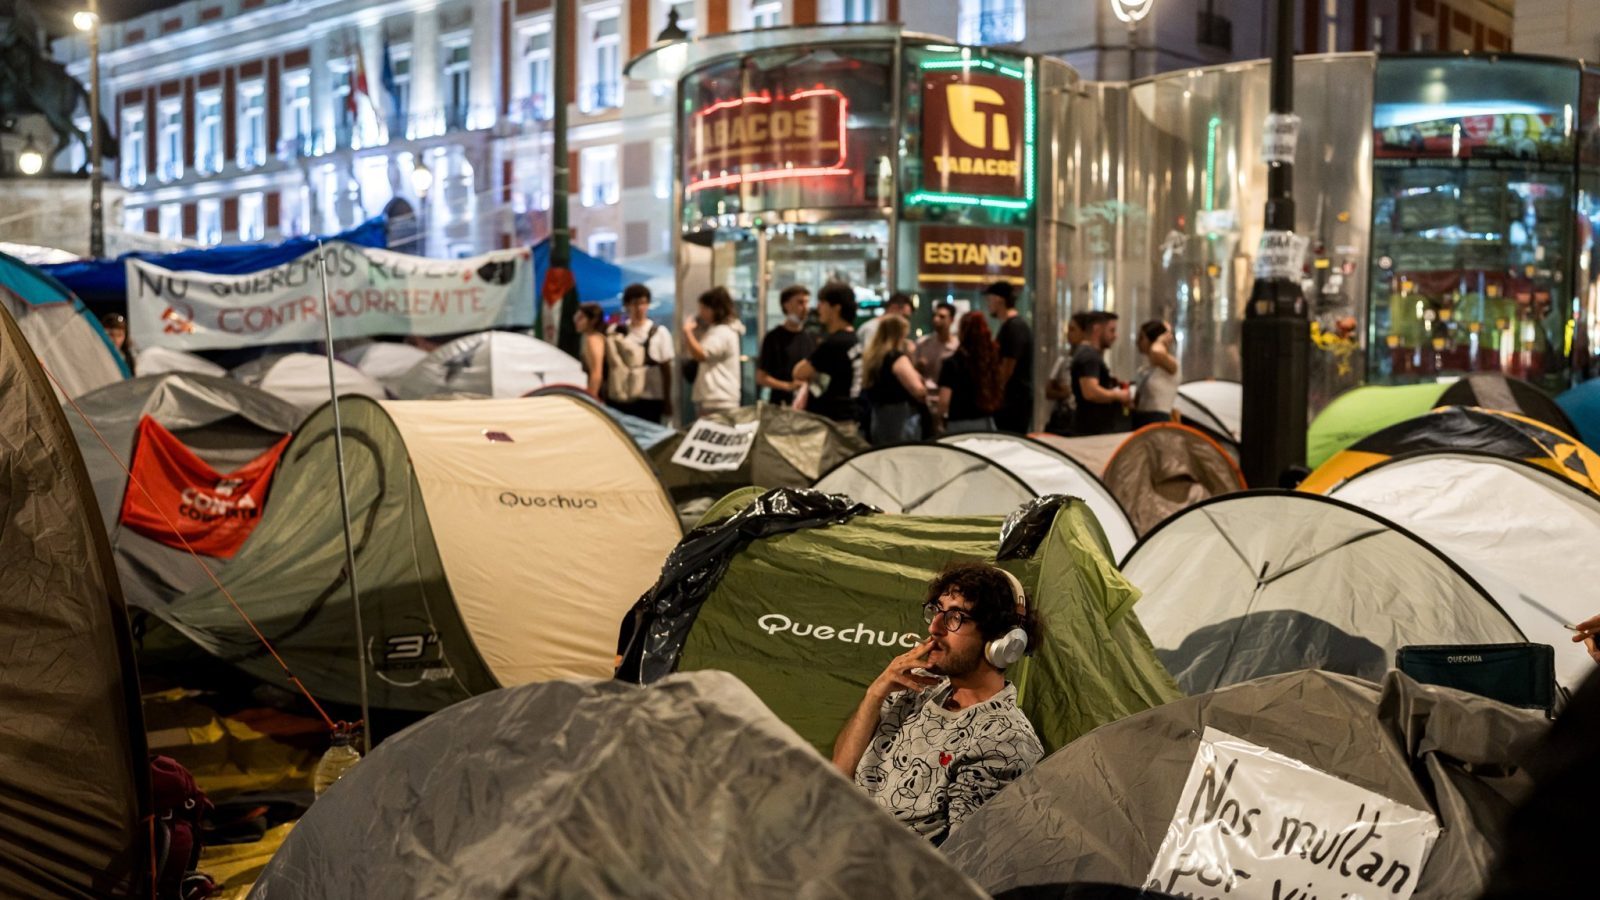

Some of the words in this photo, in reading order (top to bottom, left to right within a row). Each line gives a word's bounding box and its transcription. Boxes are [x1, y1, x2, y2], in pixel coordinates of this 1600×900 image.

[693, 108, 819, 148] ABACOS
[933, 155, 1019, 178] TABACOS
[924, 242, 1023, 268] ESTANCO
[682, 445, 695, 459] A
[498, 491, 598, 509] Quechua
[757, 613, 922, 648] Quechua
[1447, 655, 1483, 664] QUECHUA
[1188, 756, 1262, 839] Nos
[1272, 803, 1411, 893] multan
